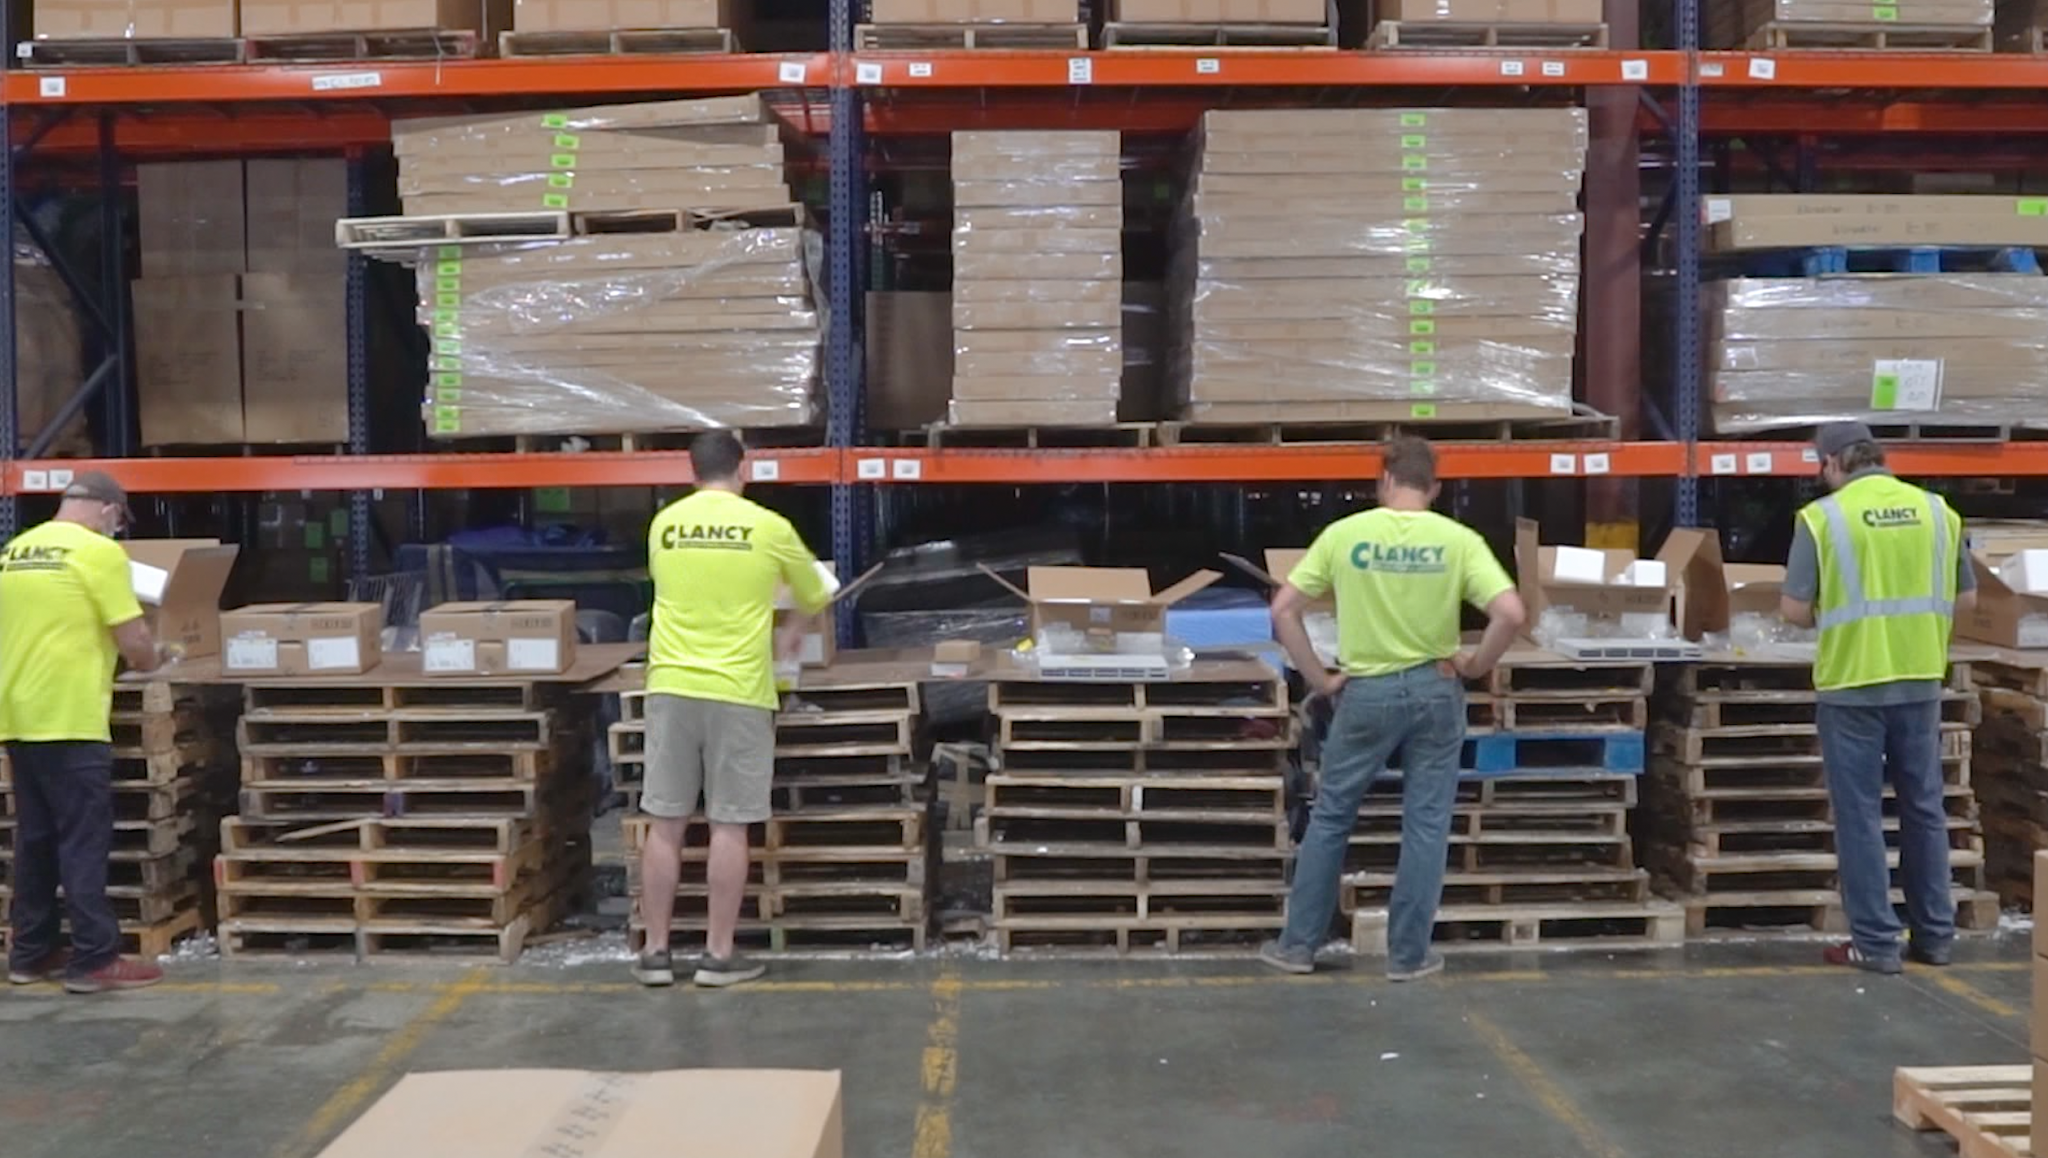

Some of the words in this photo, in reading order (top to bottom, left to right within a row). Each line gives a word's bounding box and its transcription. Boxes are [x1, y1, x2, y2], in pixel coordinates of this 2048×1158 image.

[1863, 508, 1917, 527] CLANCY
[661, 525, 753, 549] CLANCY
[1350, 542, 1445, 569] CLANCY
